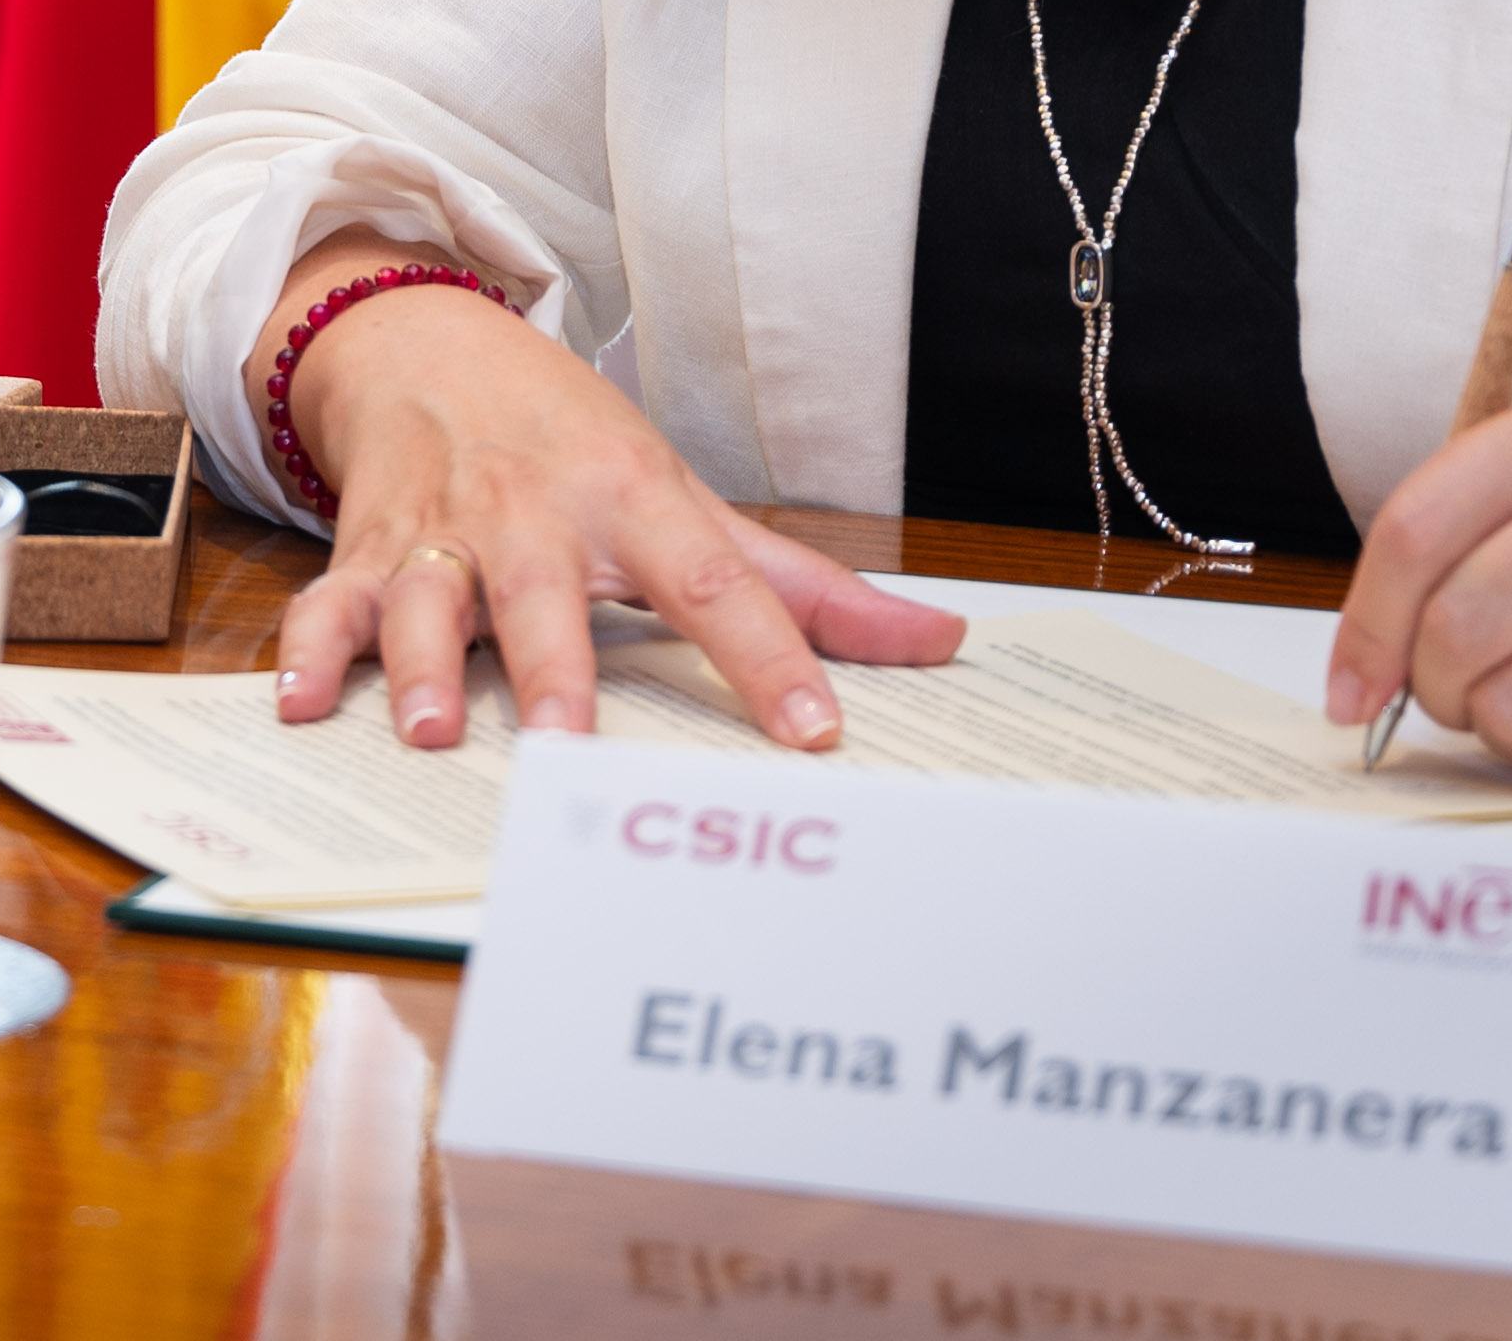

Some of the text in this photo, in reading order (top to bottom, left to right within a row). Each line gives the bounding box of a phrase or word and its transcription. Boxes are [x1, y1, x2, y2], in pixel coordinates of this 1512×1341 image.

[621, 801, 843, 875] CSIC
[630, 989, 1510, 1161] Elena Manzanera
